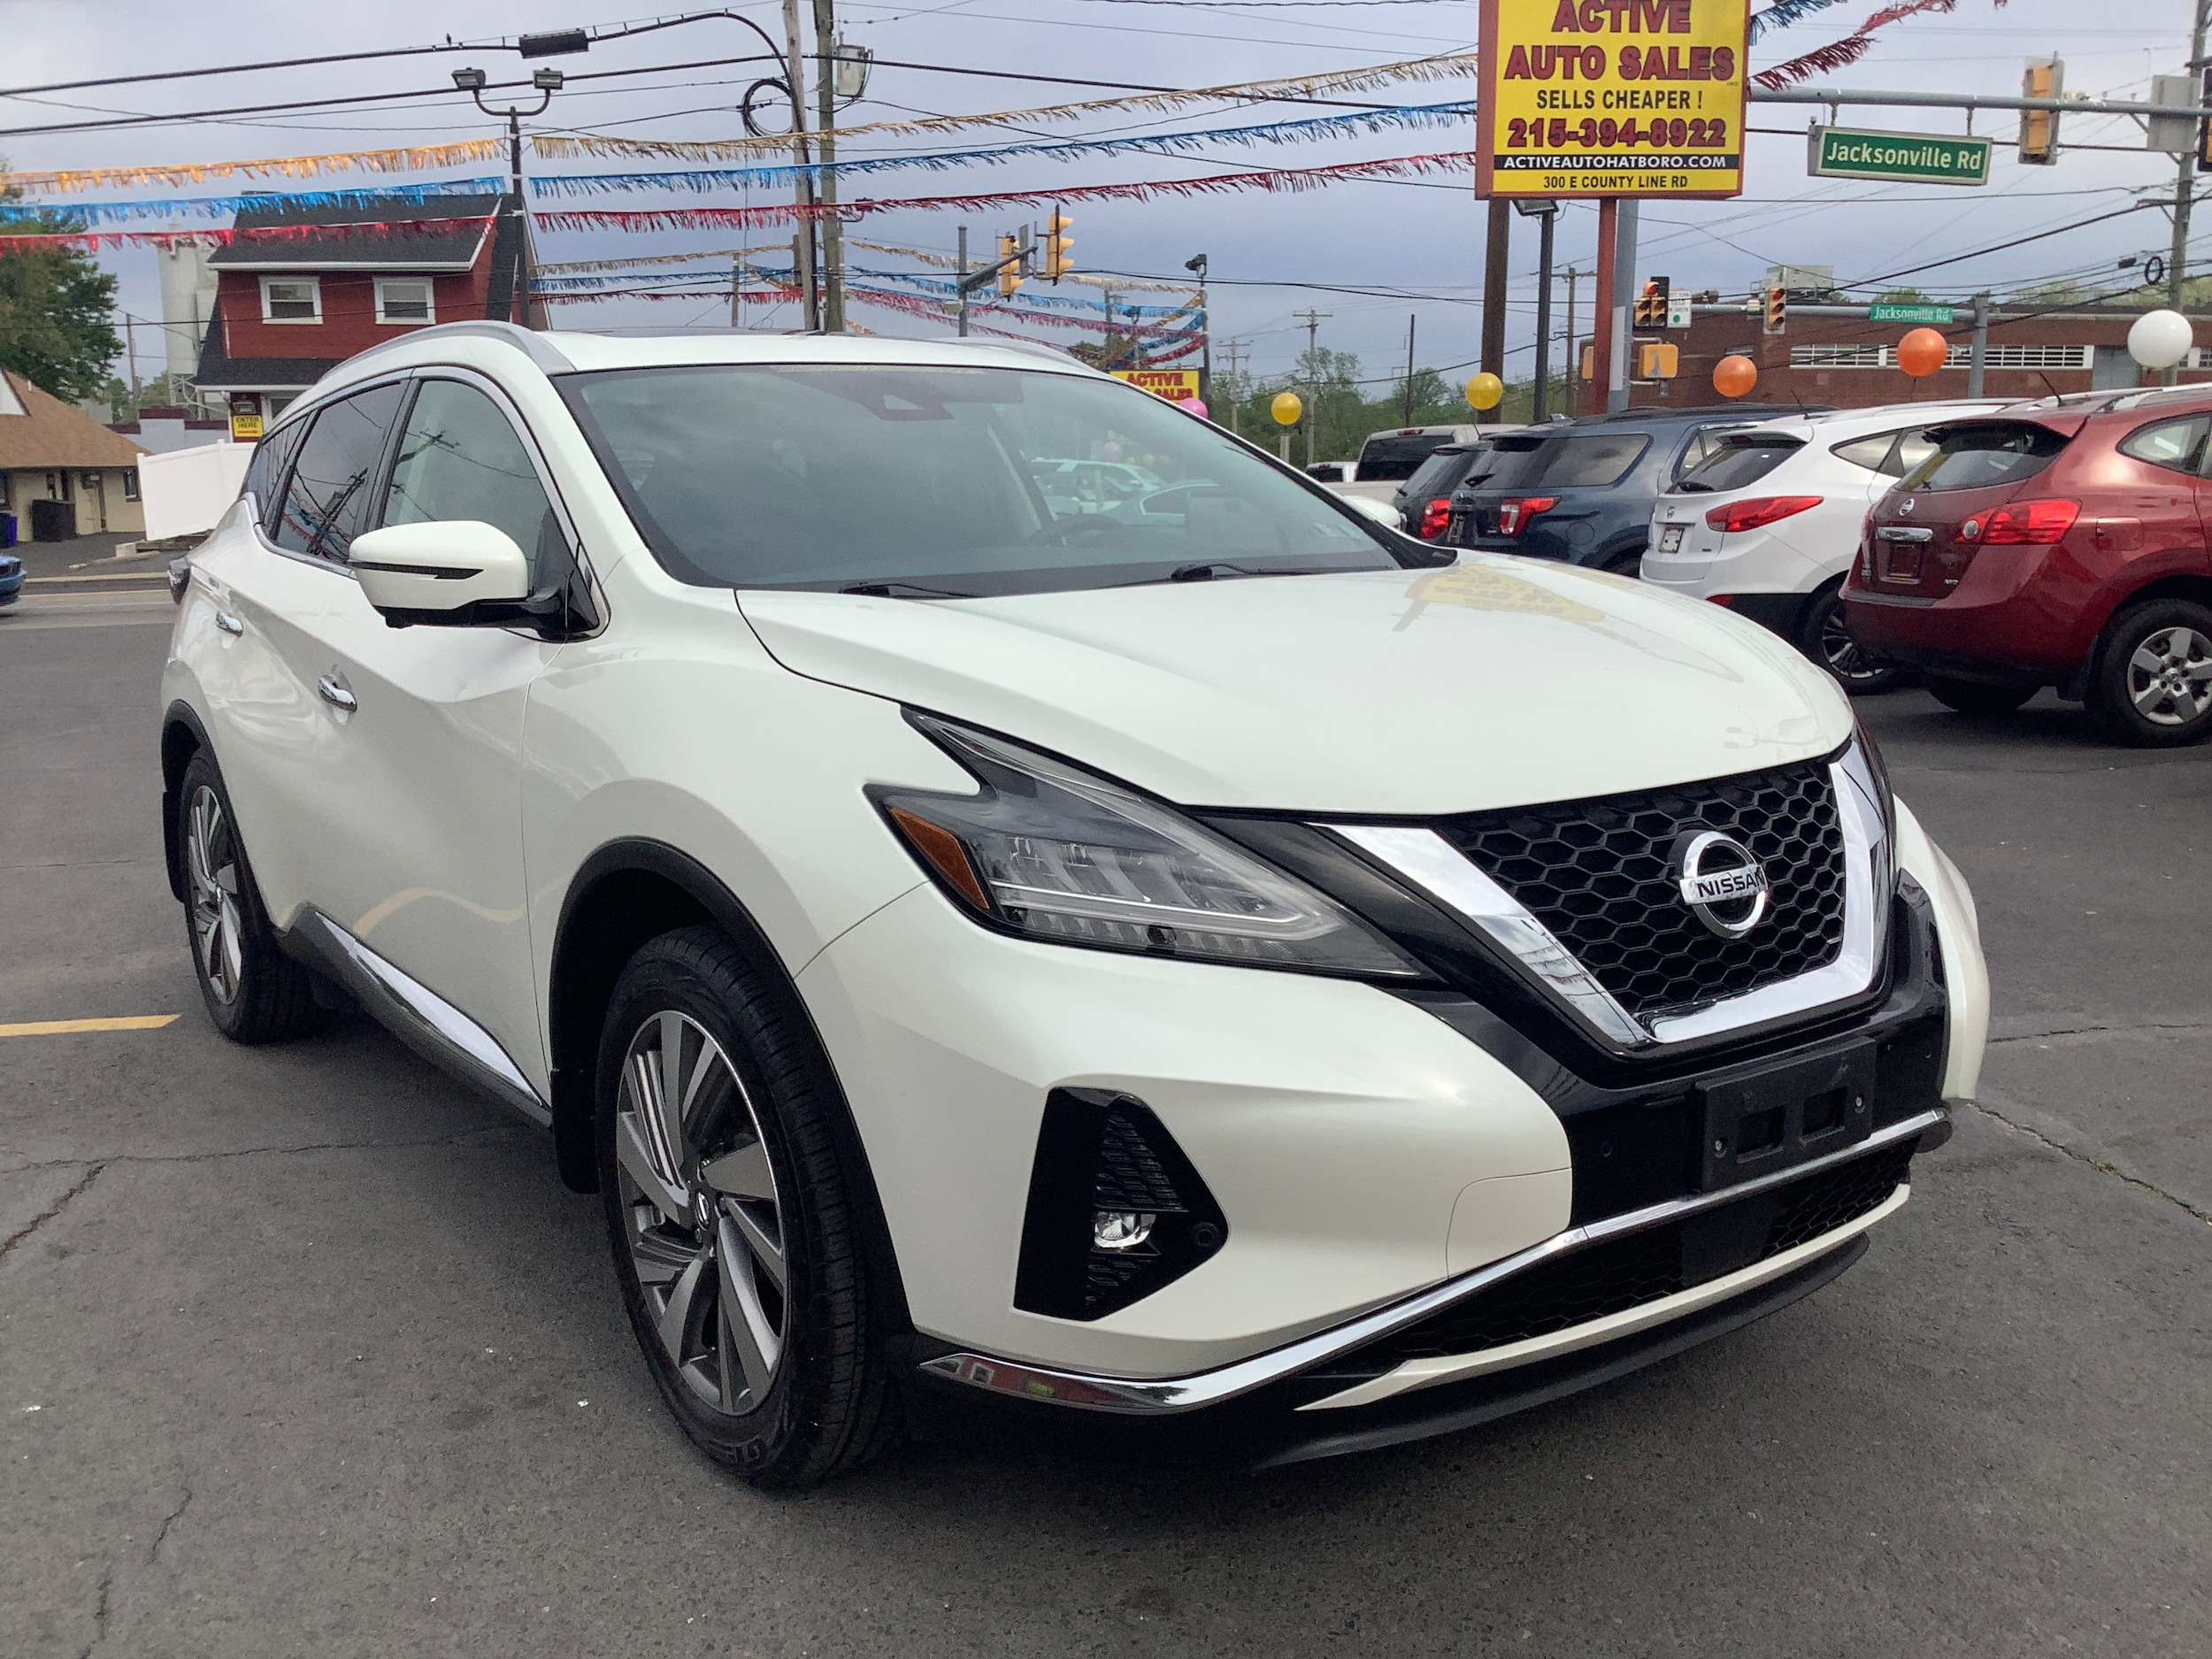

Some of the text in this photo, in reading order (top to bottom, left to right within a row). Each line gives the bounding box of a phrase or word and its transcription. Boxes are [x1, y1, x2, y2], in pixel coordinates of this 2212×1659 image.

[1551, 0, 1691, 34] ACTIVE
[1503, 45, 1735, 81] AUTO SALES
[1536, 89, 1595, 110] SELLS
[1601, 90, 1691, 110] CHEAPER
[1507, 118, 1726, 149] 215-394-8922
[1503, 156, 1726, 169] ACTIVEAUTOHATBORO.COM
[1826, 142, 1982, 170] Jacksonville Rd
[1543, 176, 1688, 188] 300 E COUNTY LINE RD
[1874, 306, 1949, 321] Jacksonville Rd
[1126, 373, 1184, 387] ACTIVE
[1696, 866, 1766, 898] NISSAN
